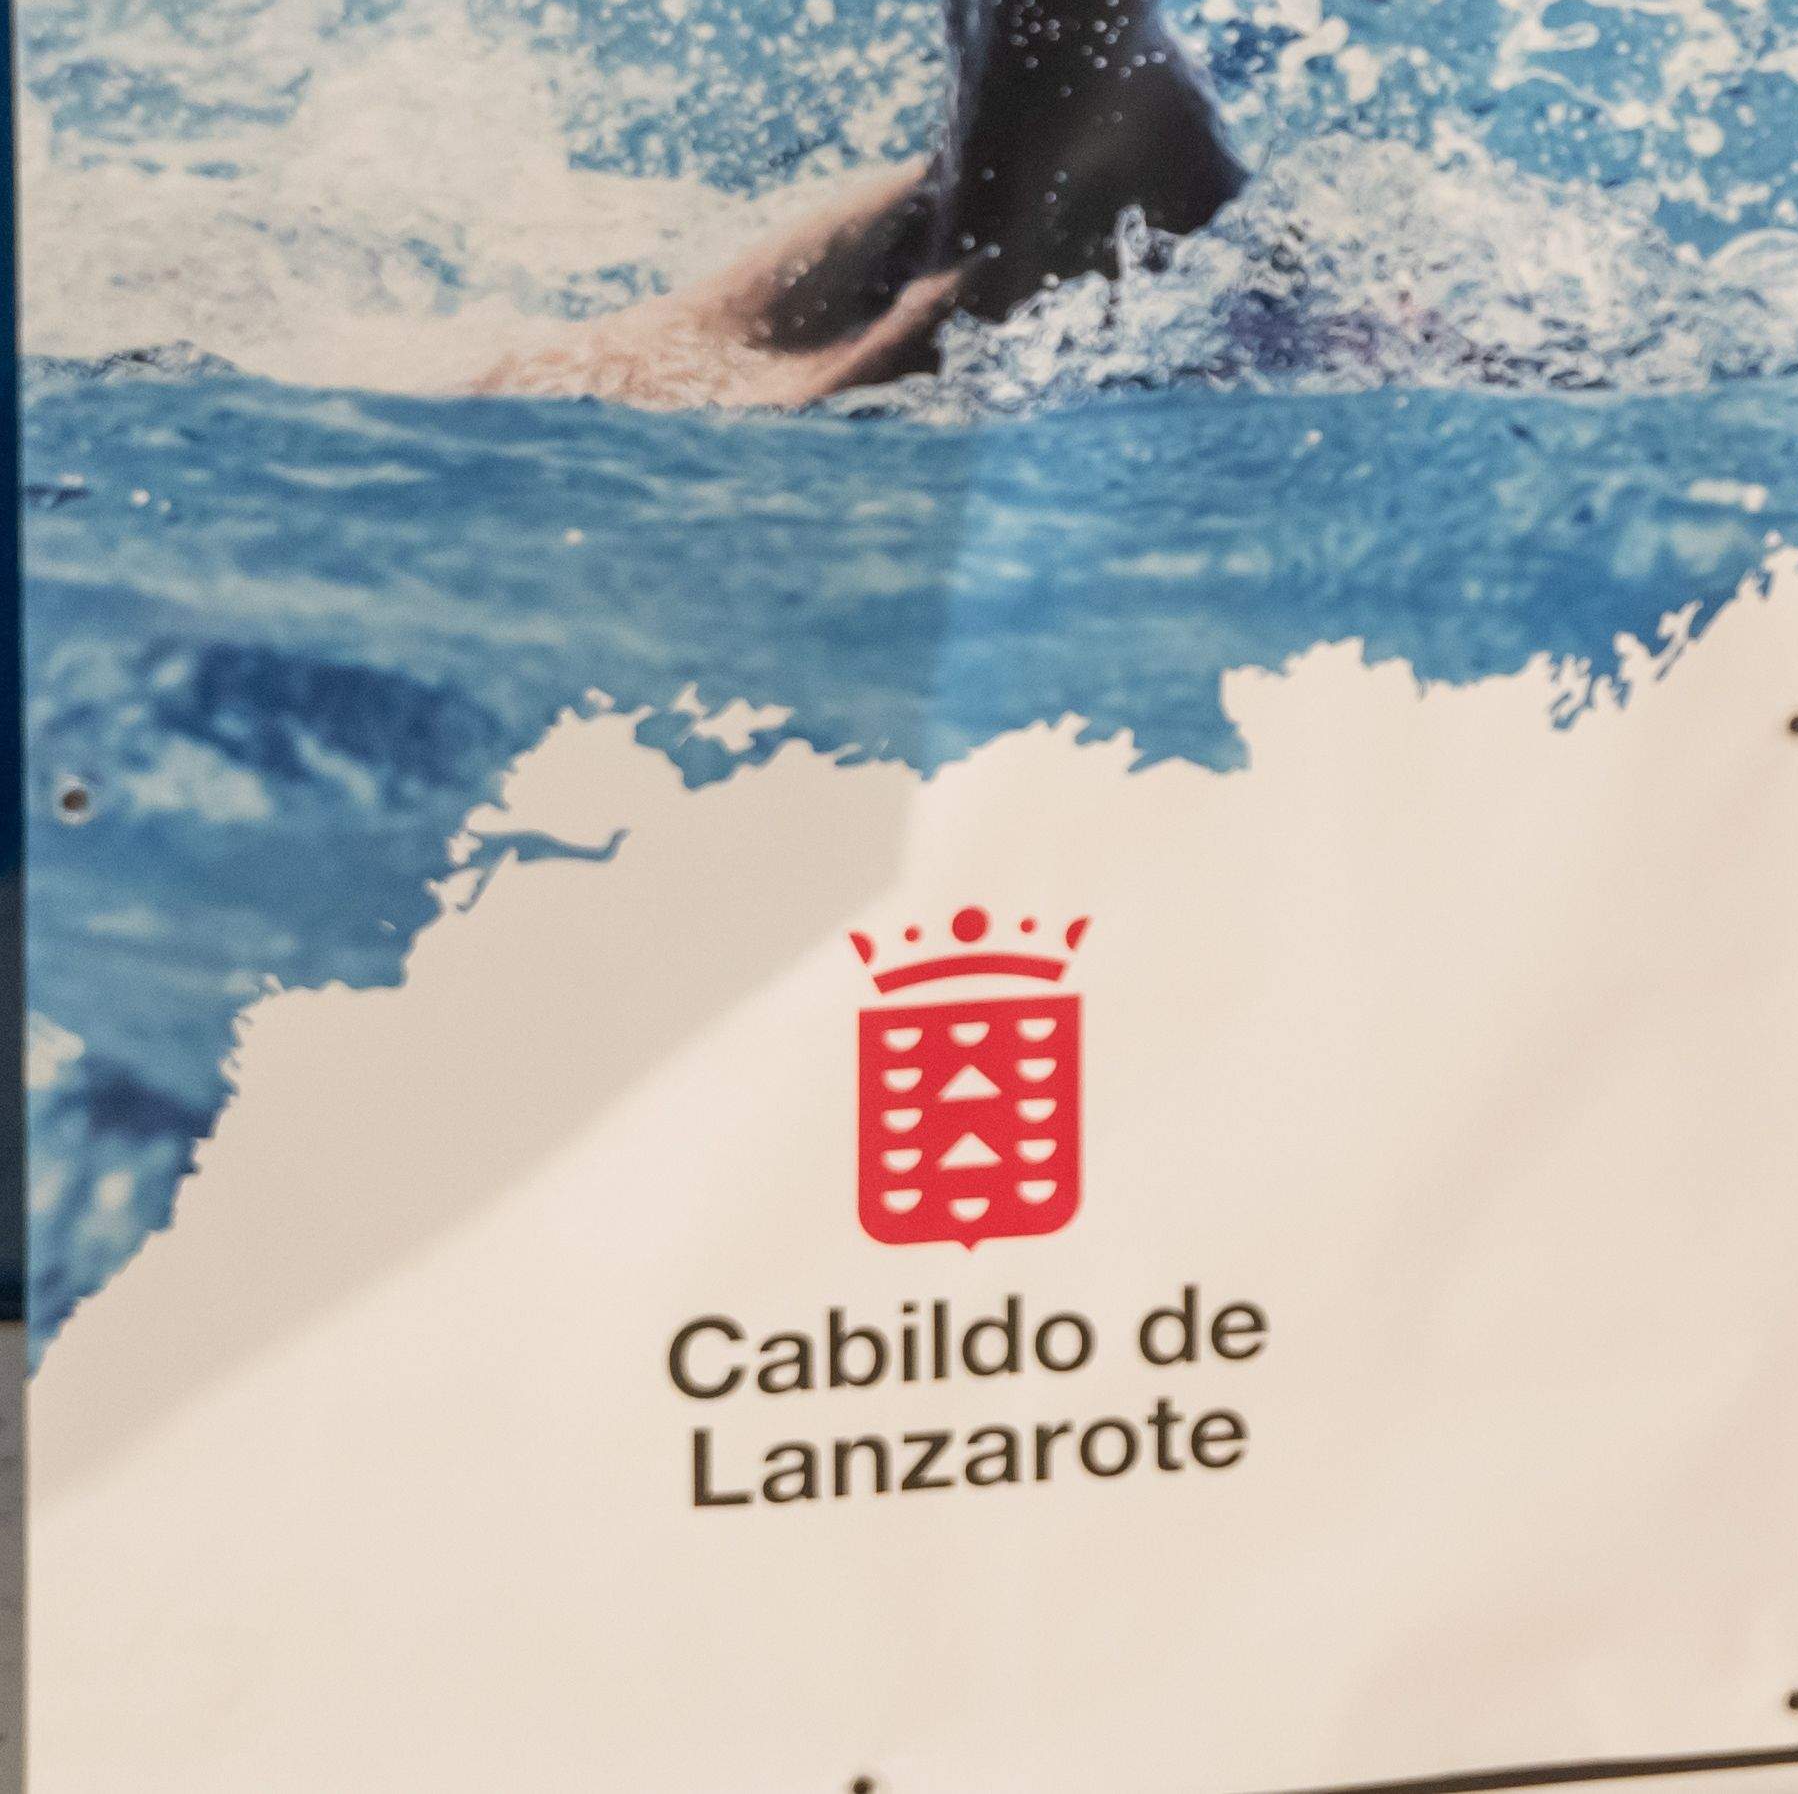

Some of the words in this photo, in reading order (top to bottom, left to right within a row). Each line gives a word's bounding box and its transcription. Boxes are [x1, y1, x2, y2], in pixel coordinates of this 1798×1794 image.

[668, 1293, 1096, 1400] Cabildo
[1138, 1284, 1269, 1367] de
[693, 1397, 1249, 1508] Lanzarote
